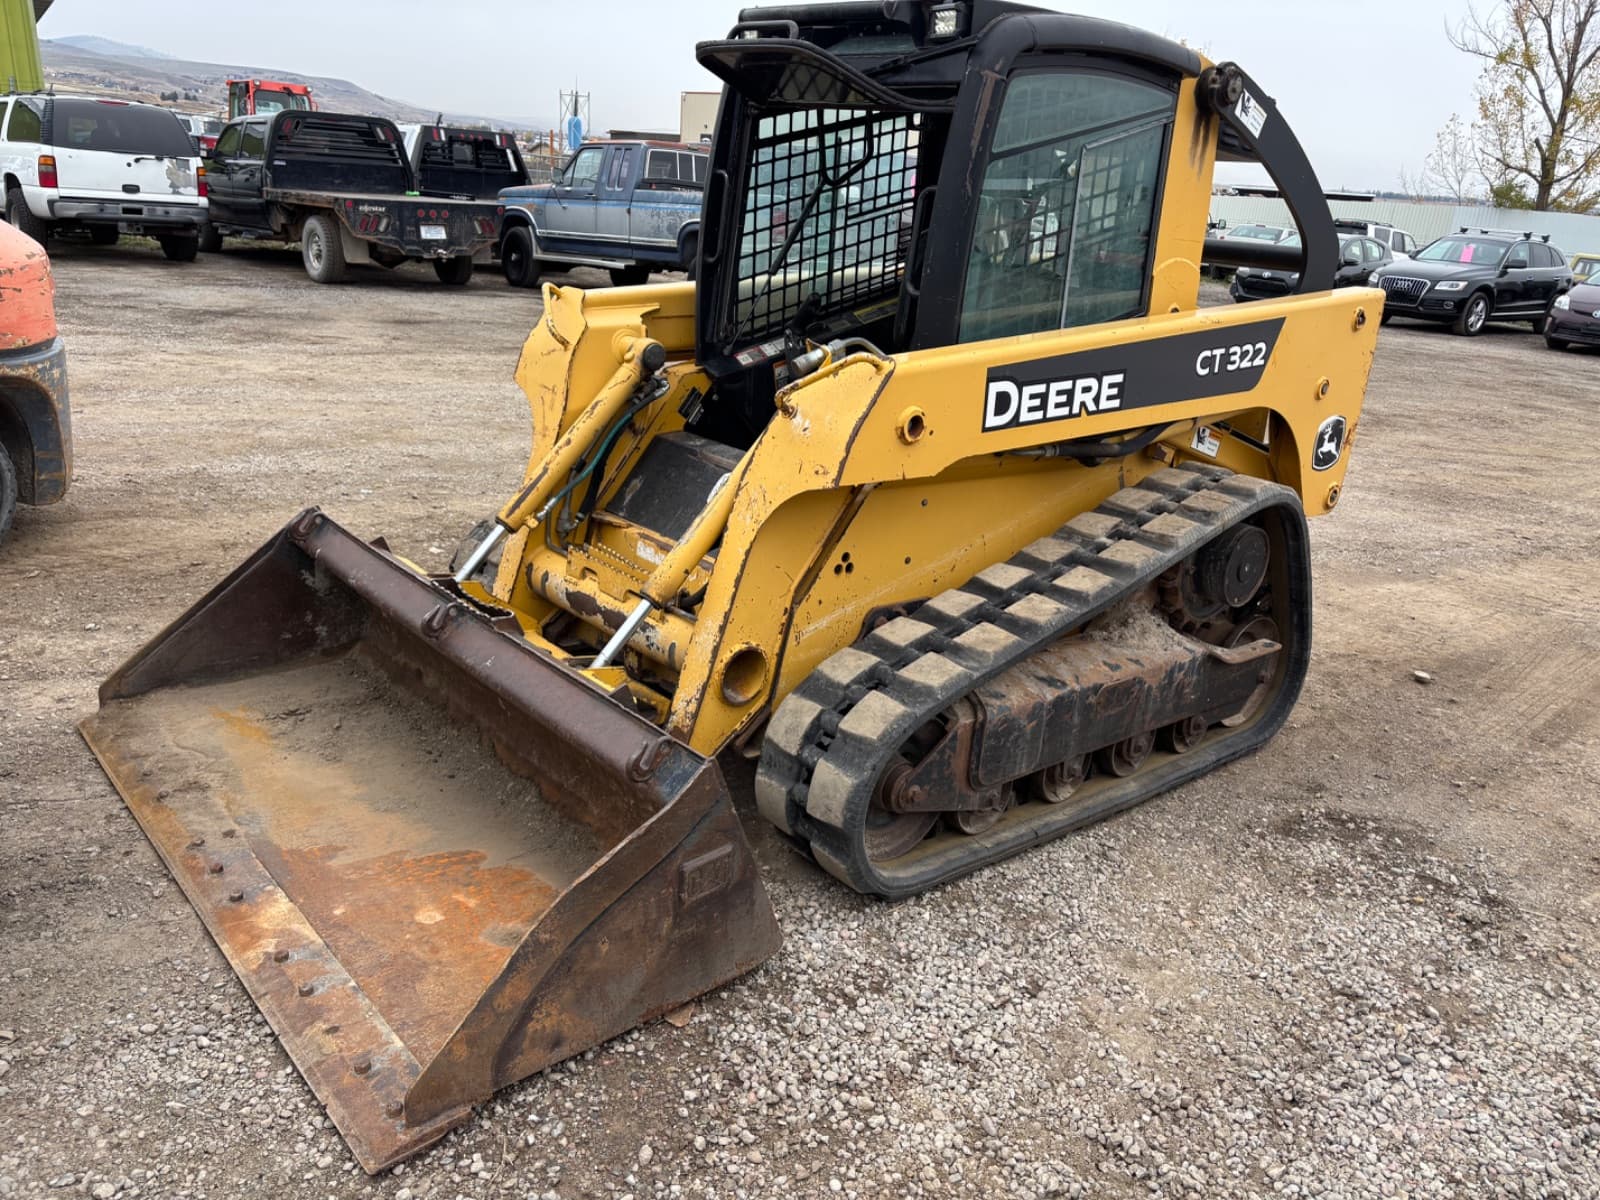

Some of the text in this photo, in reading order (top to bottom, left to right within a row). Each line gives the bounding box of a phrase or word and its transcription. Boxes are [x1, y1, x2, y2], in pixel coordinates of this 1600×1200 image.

[1196, 341, 1267, 376] CT 322
[985, 374, 1124, 428] DEERE
